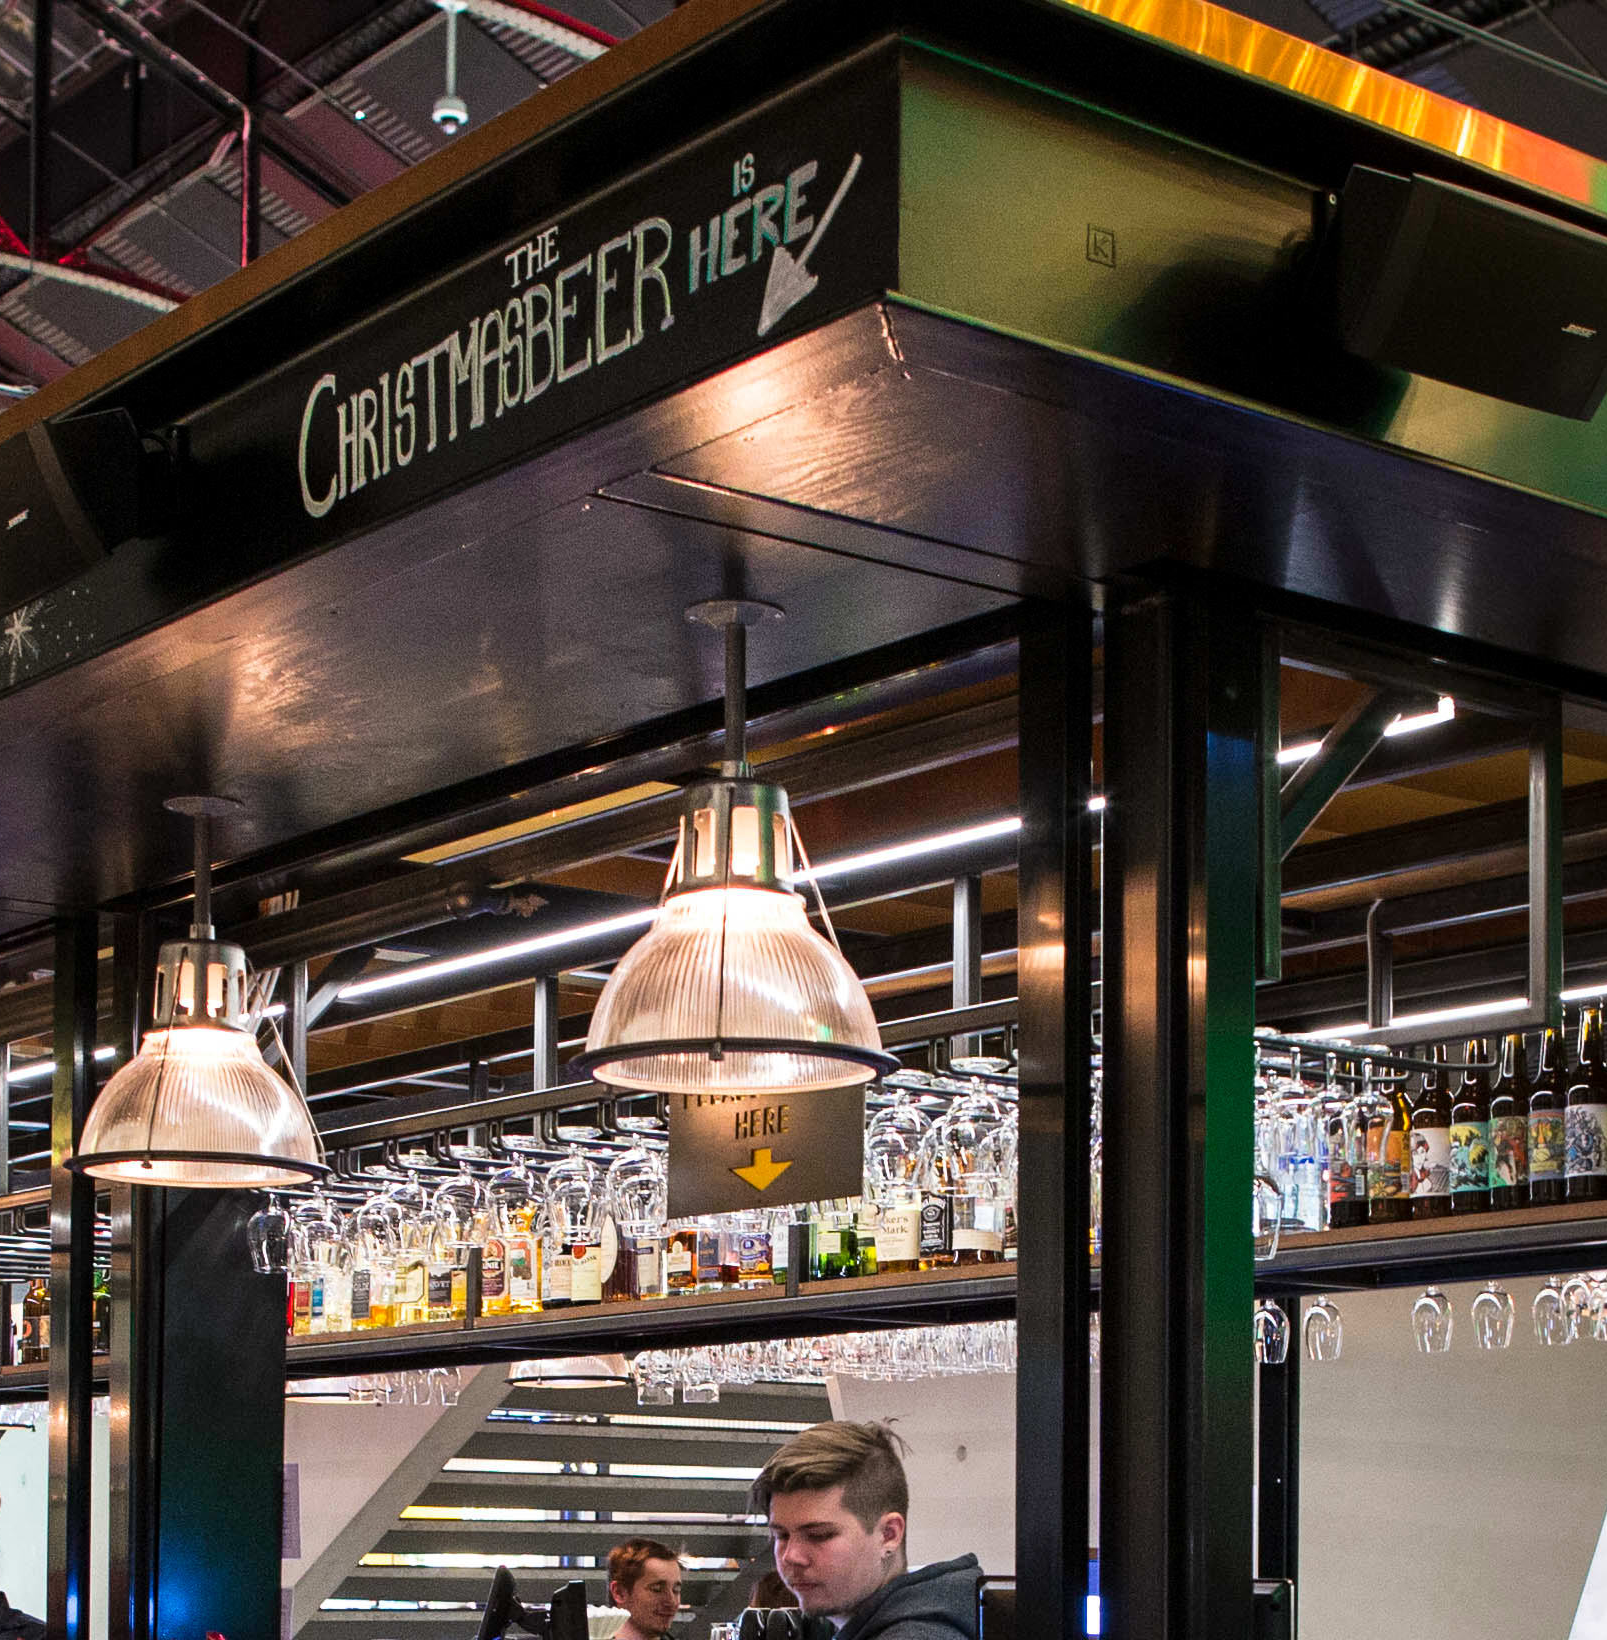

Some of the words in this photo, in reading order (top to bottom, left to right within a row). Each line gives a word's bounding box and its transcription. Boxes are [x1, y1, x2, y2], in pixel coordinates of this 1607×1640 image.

[733, 153, 756, 195] IS
[505, 226, 561, 289] THE
[299, 296, 527, 518] CHRISTMAS
[523, 216, 675, 404] BEER
[689, 160, 818, 295] HERE
[735, 1104, 790, 1139] HERE
